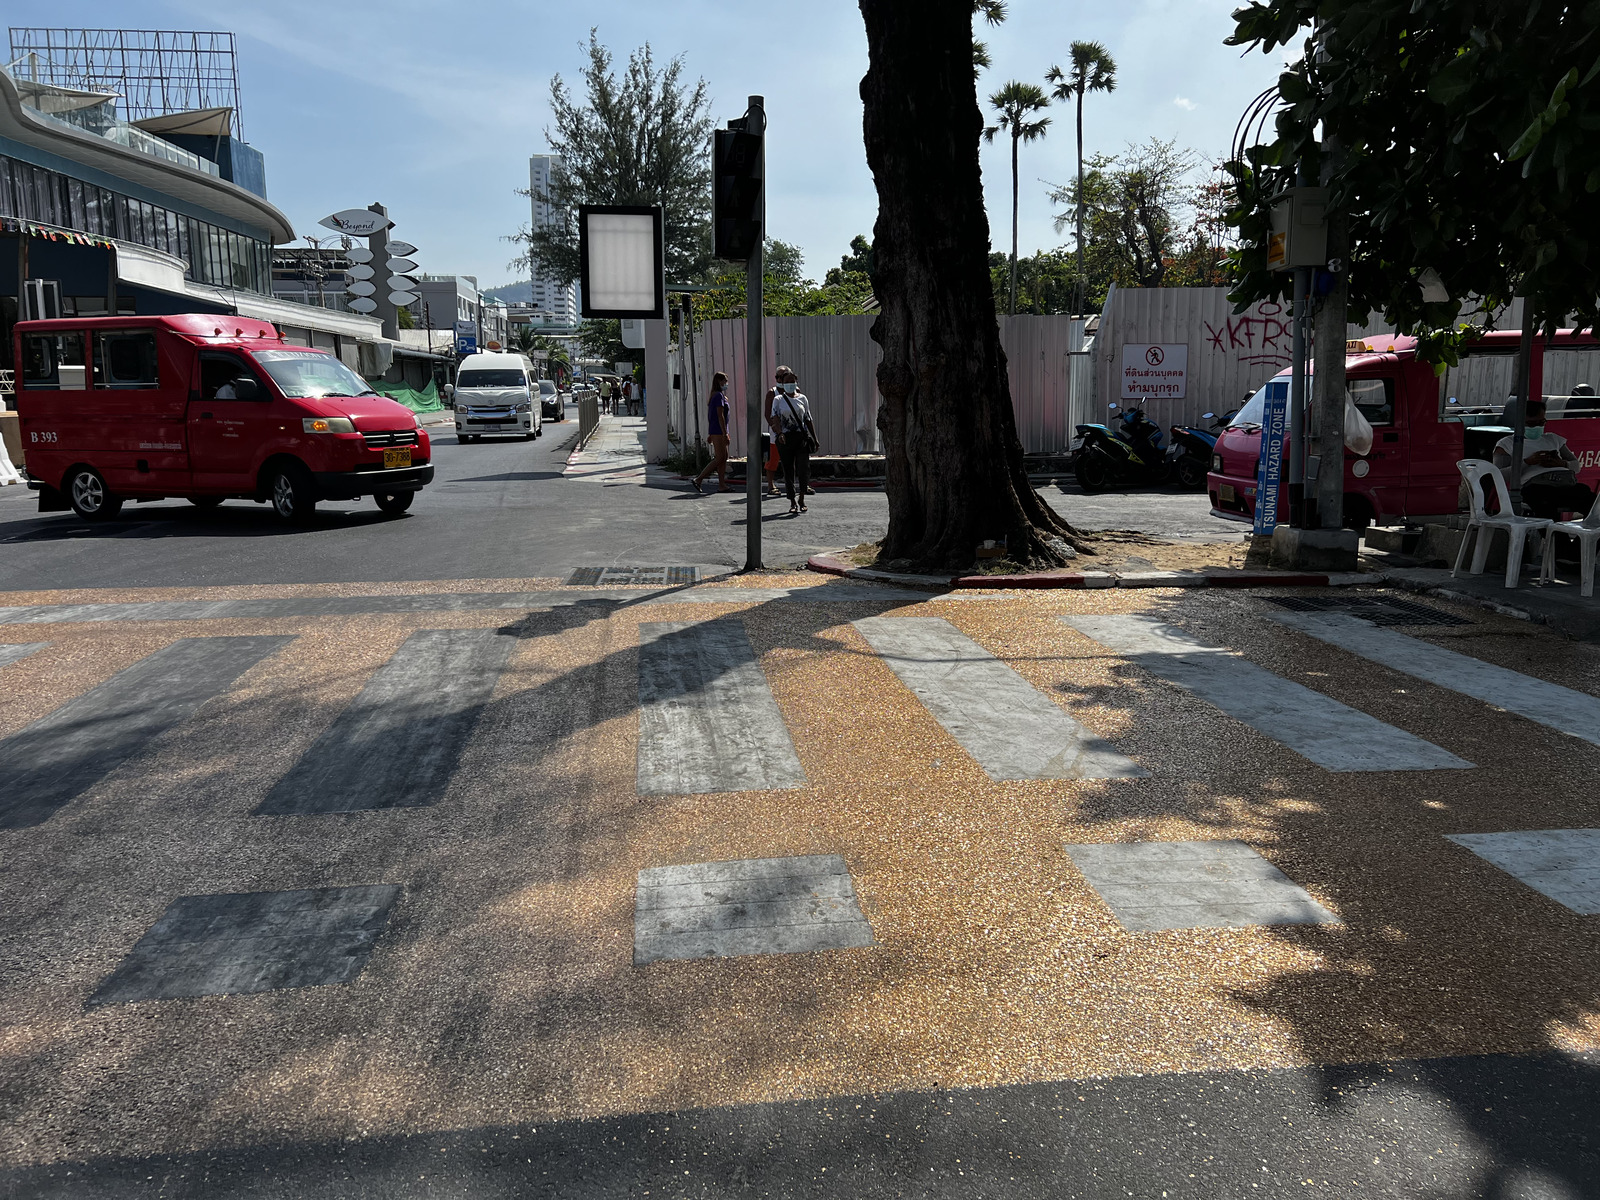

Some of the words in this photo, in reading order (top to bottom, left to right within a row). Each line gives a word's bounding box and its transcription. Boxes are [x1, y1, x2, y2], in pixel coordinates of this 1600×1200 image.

[340, 219, 376, 233] Beyond
[458, 339, 468, 350] P
[1124, 365, 1184, 380] ที่ดินส่วนบุคคล
[1127, 380, 1179, 397] ห้ามบุกรุก
[1271, 408, 1284, 436] ZONE
[30, 431, 39, 443] B
[40, 431, 58, 443] 393
[1267, 439, 1281, 480] HAZARD
[1263, 484, 1278, 529] TSUNAMI
